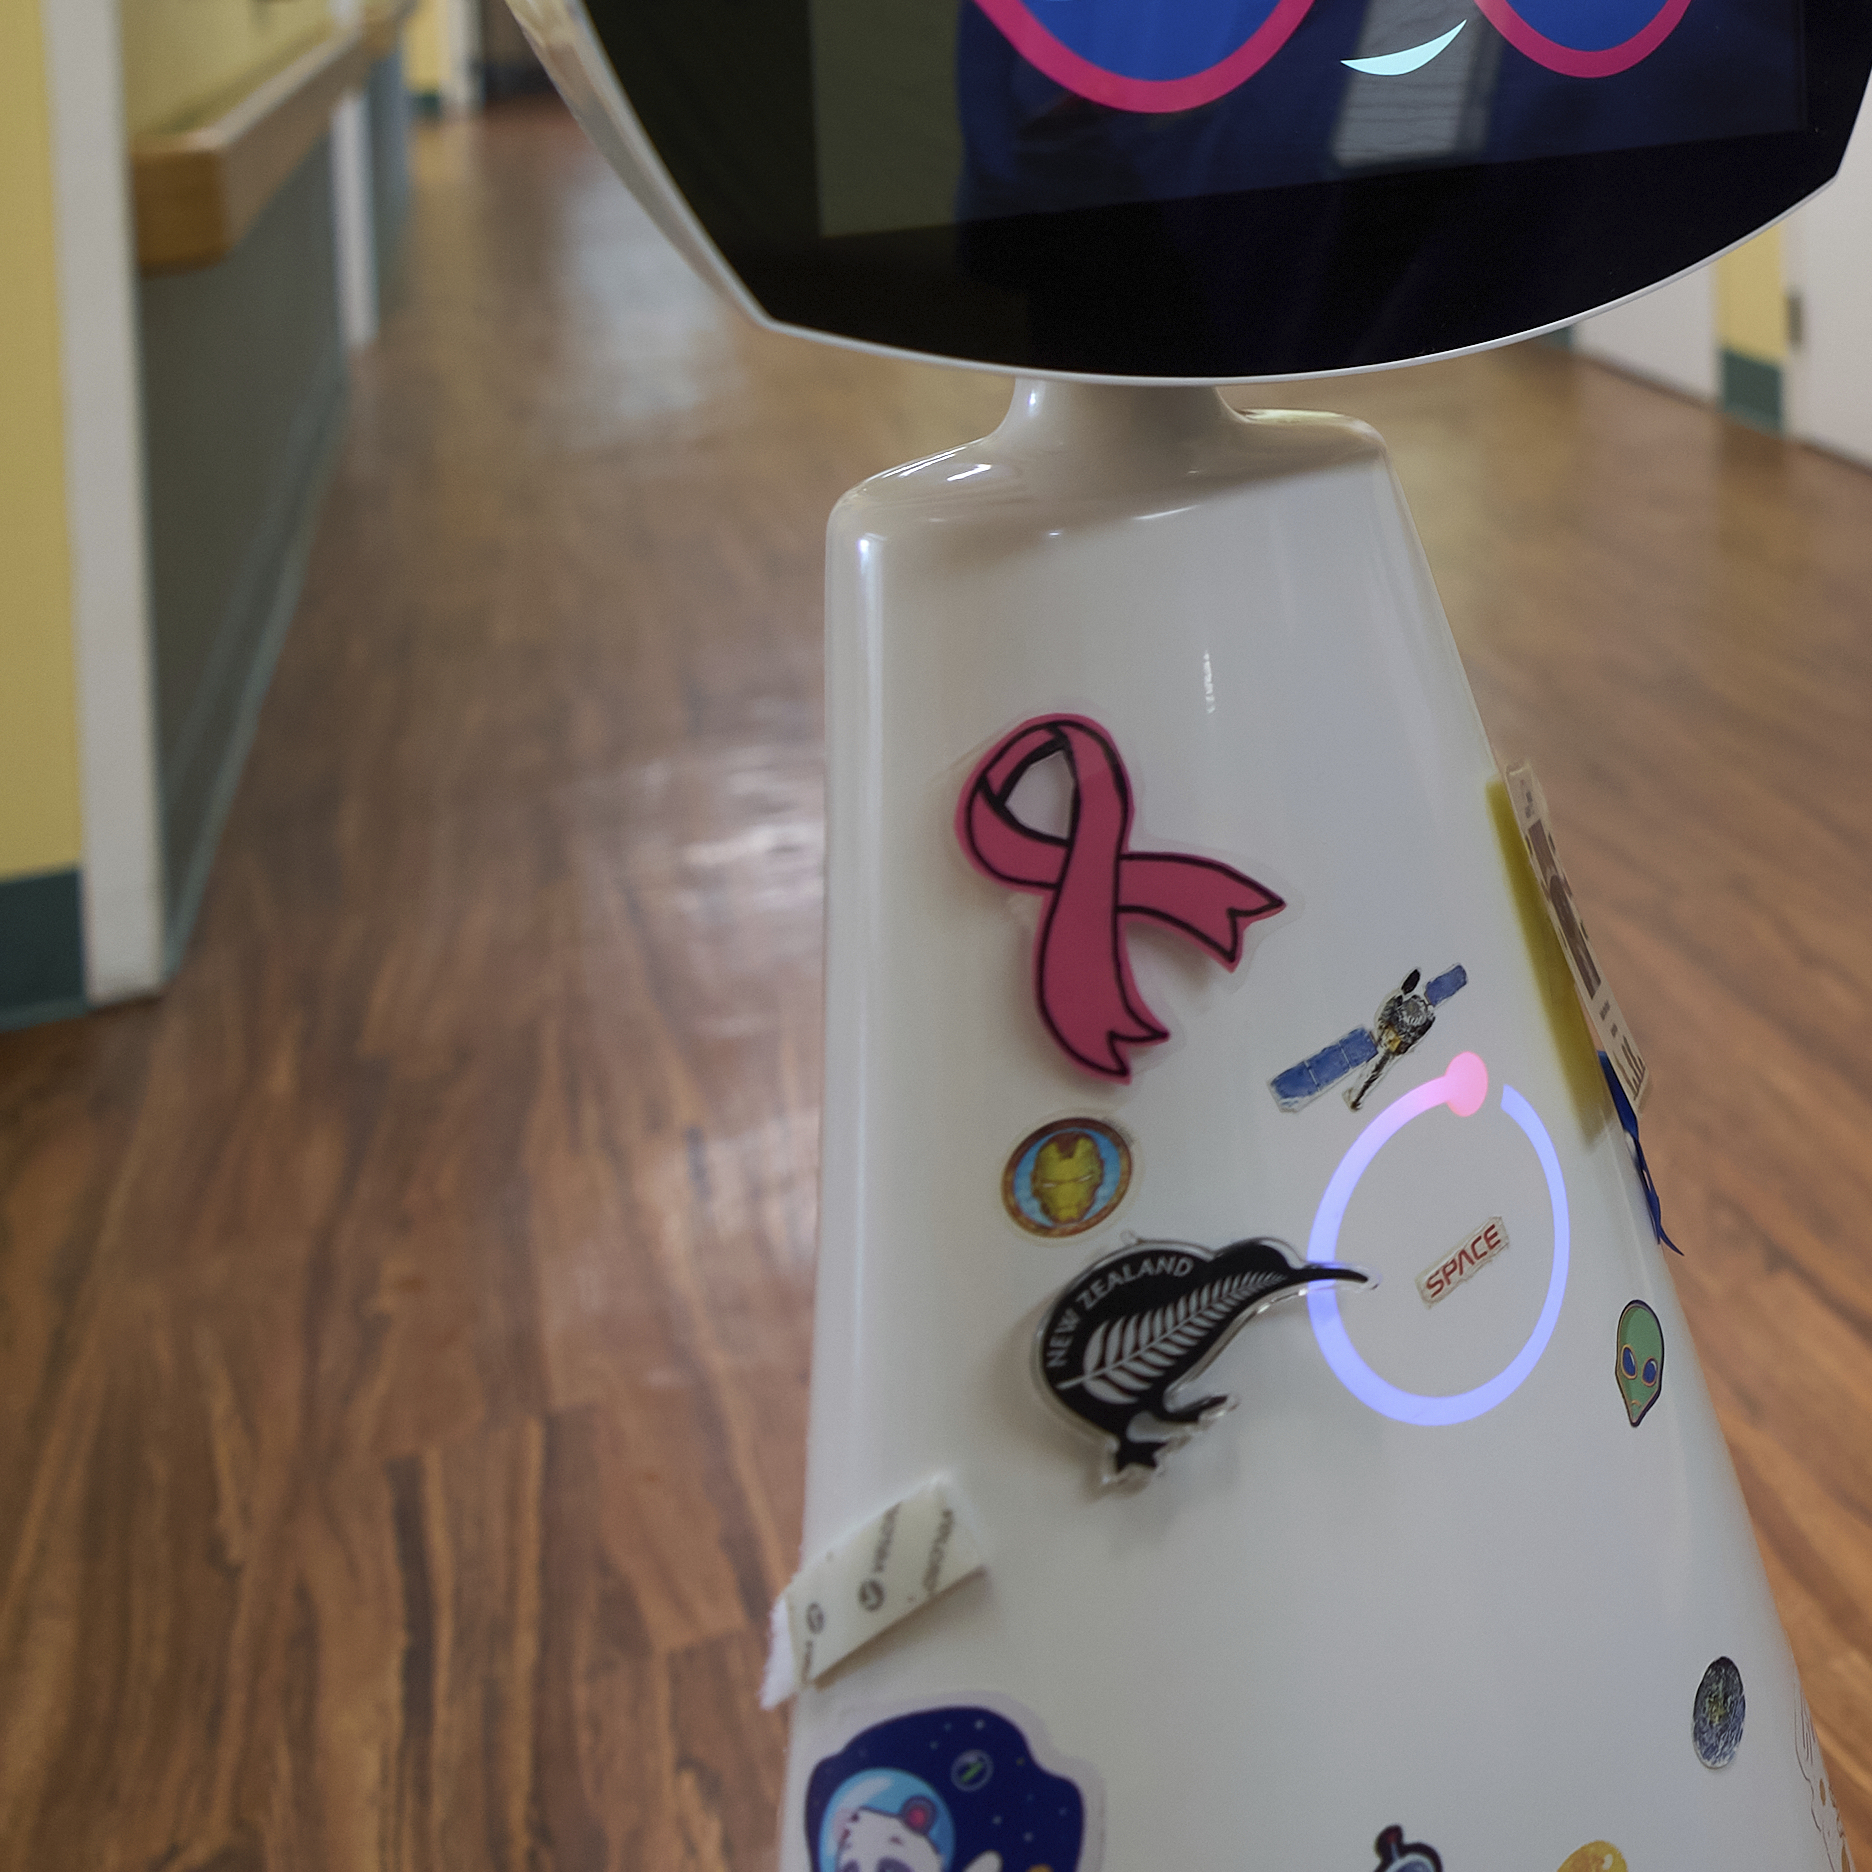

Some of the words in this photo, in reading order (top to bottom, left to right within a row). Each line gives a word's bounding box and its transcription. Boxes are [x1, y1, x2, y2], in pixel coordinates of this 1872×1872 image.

[1426, 1223, 1502, 1299] SPACE
[1046, 1308, 1081, 1368] NEW
[1075, 1256, 1195, 1310] ZEALAND
